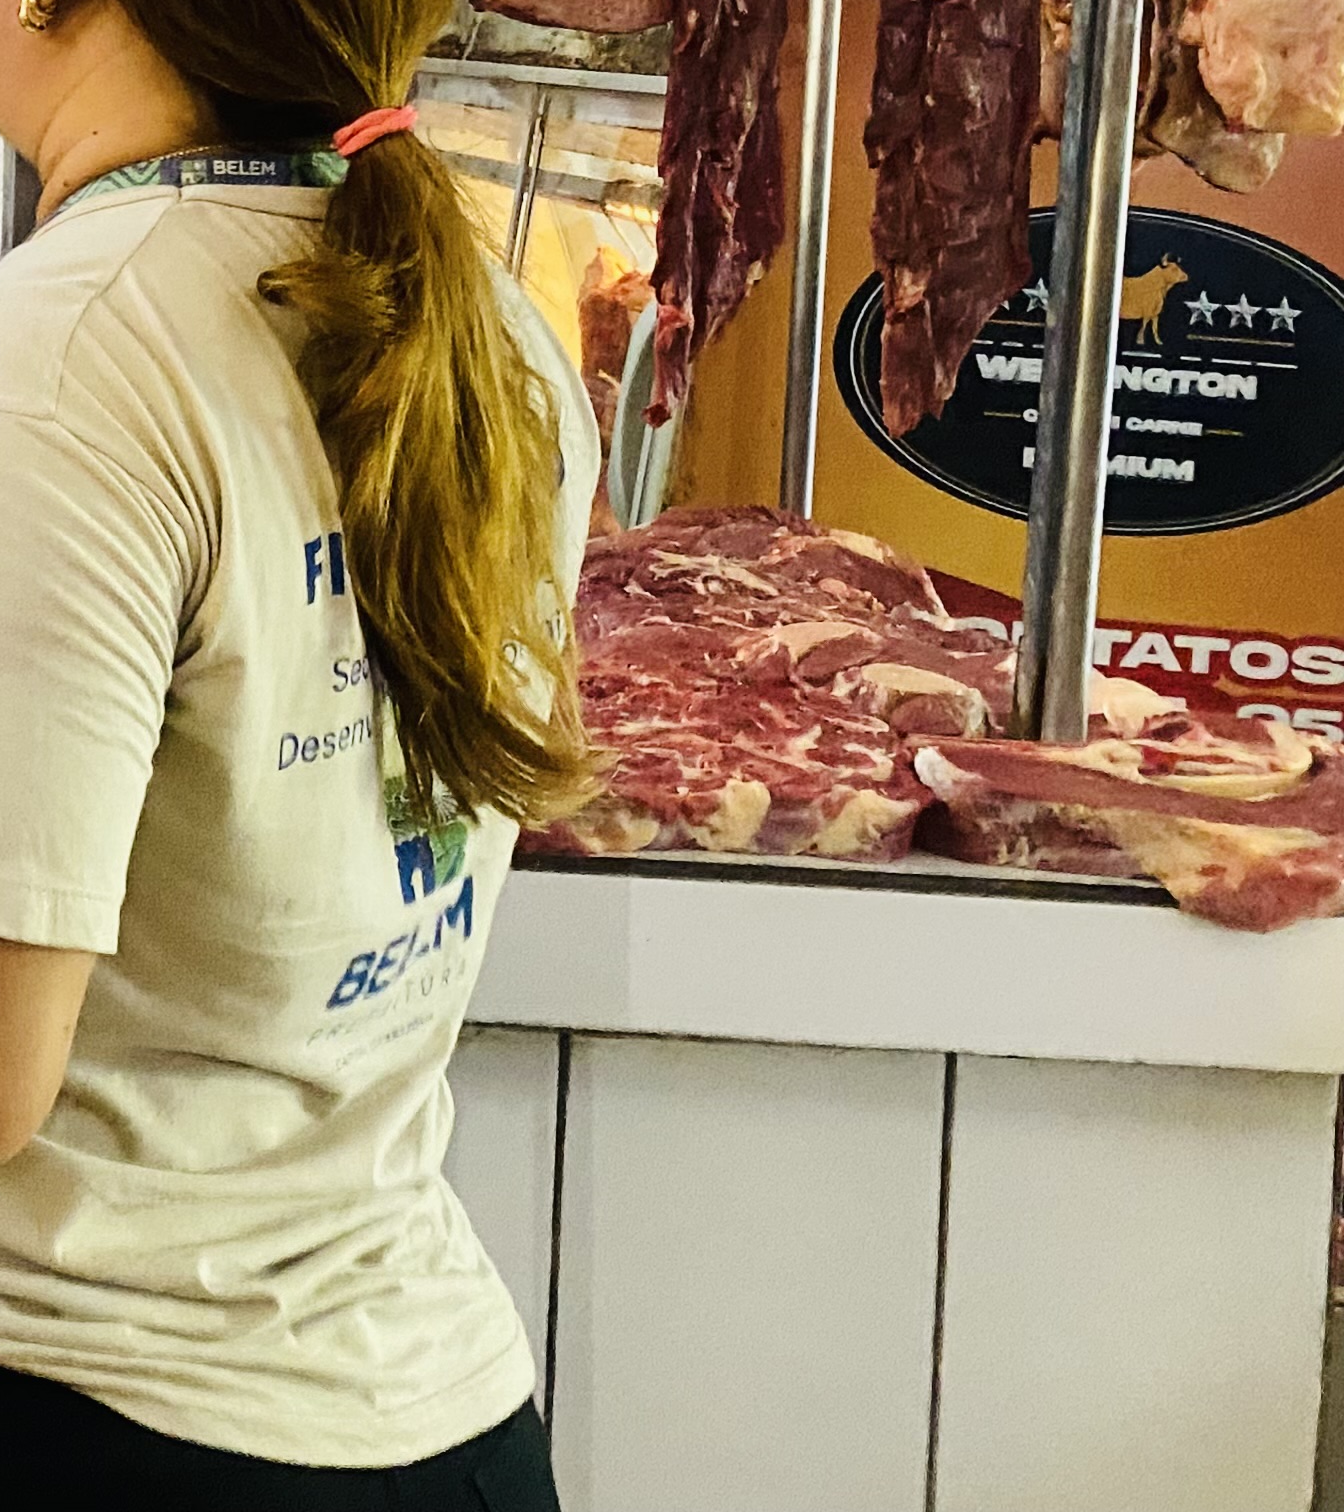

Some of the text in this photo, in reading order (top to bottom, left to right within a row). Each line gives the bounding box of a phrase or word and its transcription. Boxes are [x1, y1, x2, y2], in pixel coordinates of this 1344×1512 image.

[976, 353, 1257, 400] WENGTON
[304, 532, 346, 605] FI
[278, 718, 372, 771] Desenv
